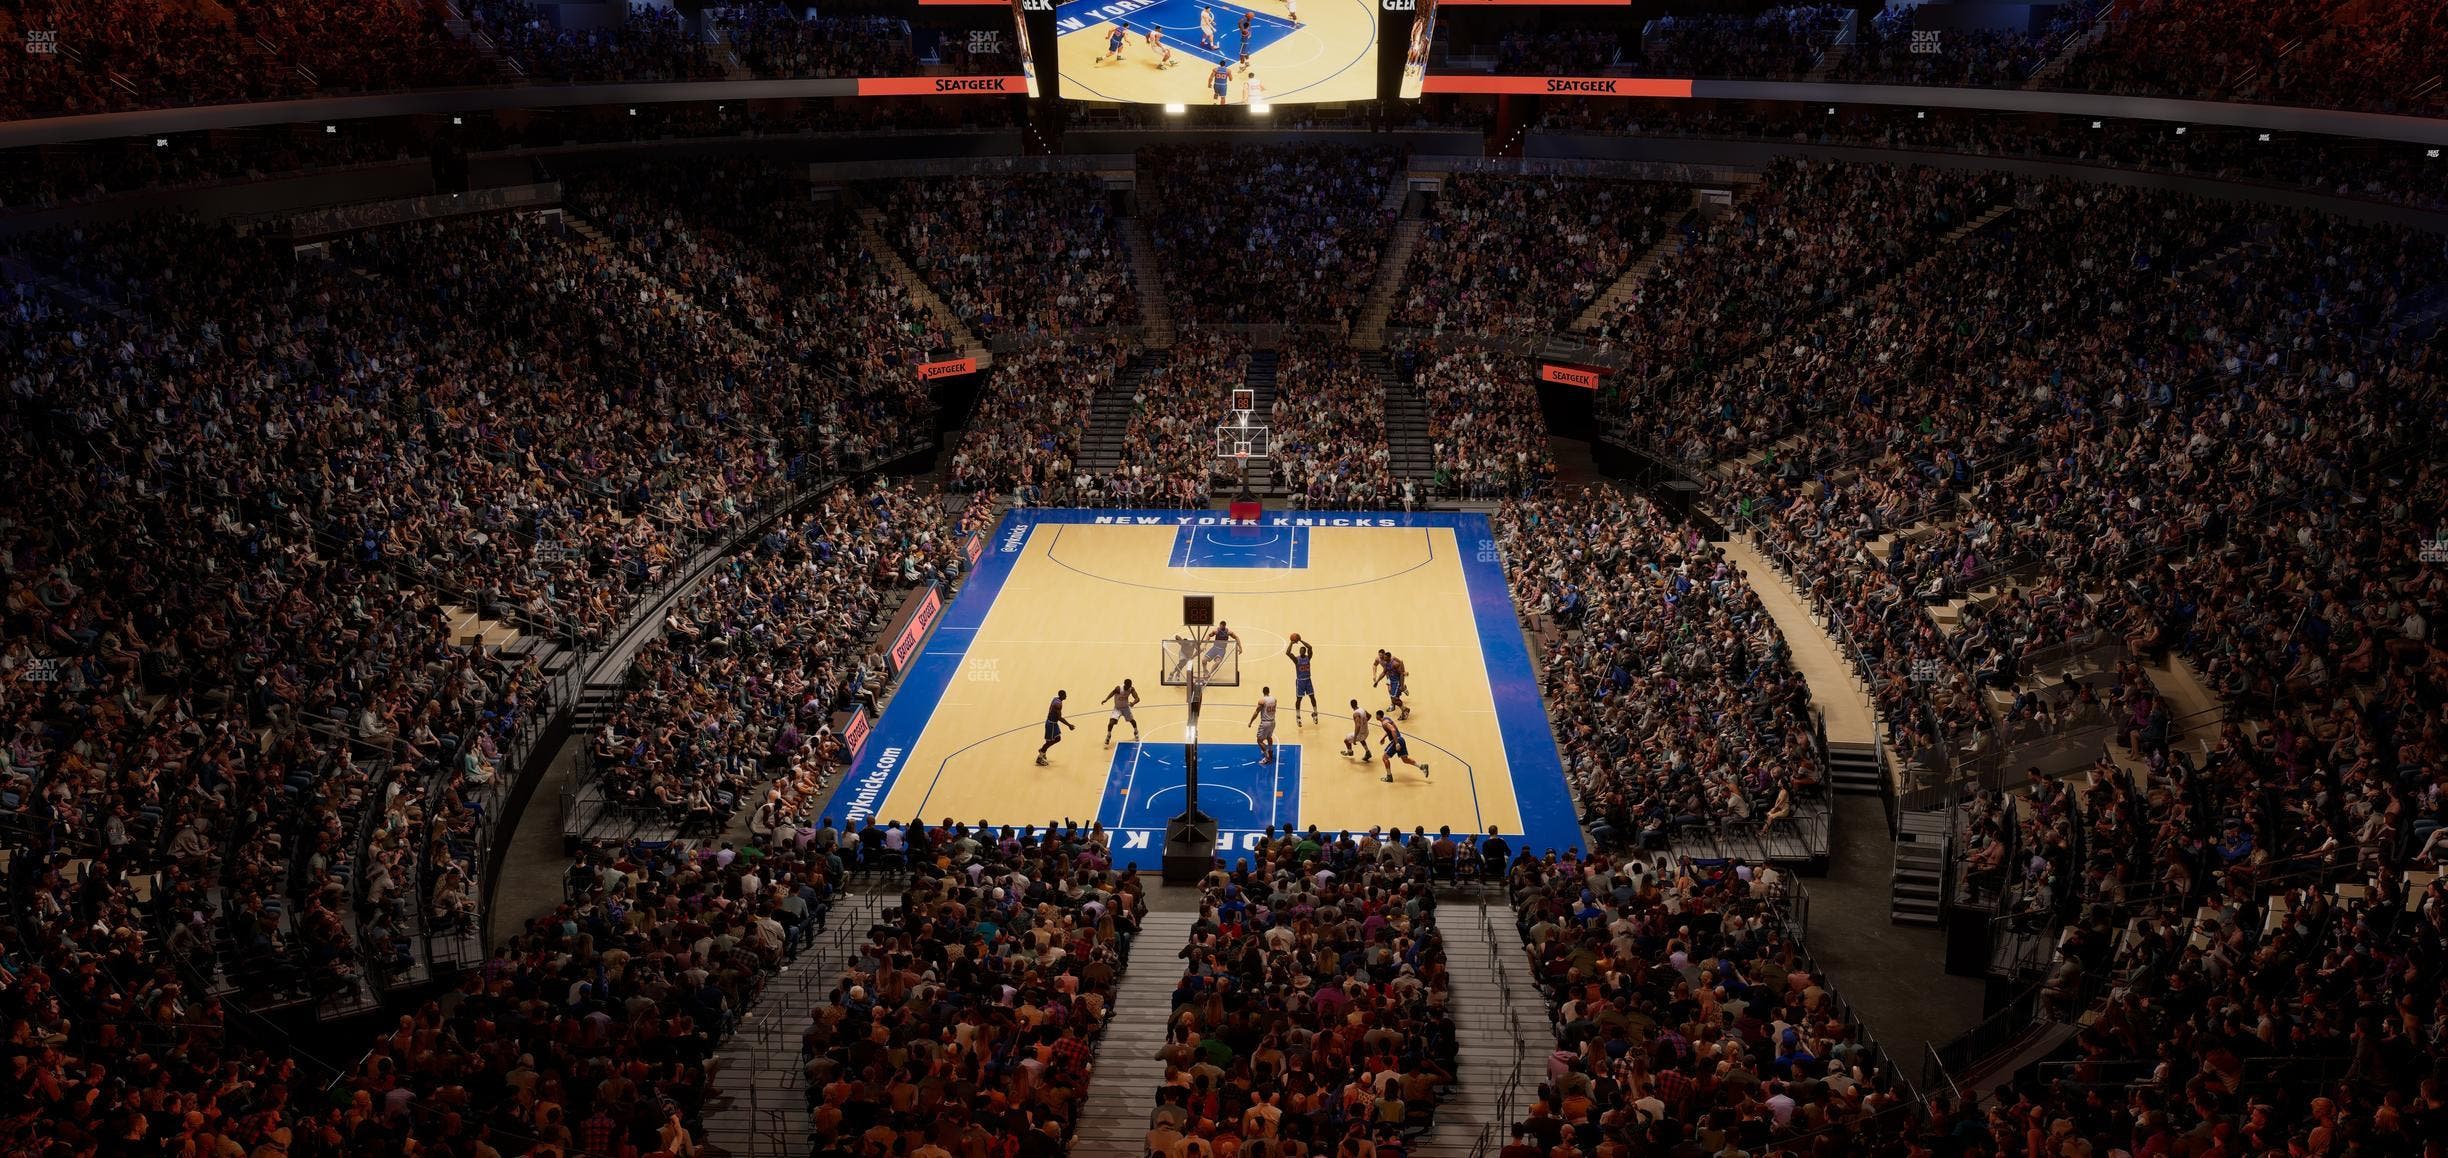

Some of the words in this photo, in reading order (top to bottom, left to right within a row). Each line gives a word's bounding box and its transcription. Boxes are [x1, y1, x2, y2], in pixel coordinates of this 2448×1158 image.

[936, 79, 1005, 91] SEATGEEK
[1547, 79, 1616, 92] SEATGEEK
[928, 363, 966, 376] SEATGEEK
[1552, 371, 1589, 385] SEATGEEK
[1095, 516, 1161, 525] NEW
[1177, 517, 1257, 525] YORK
[1273, 518, 1396, 527] KNICKS
[845, 747, 902, 821] nyknicks.com
